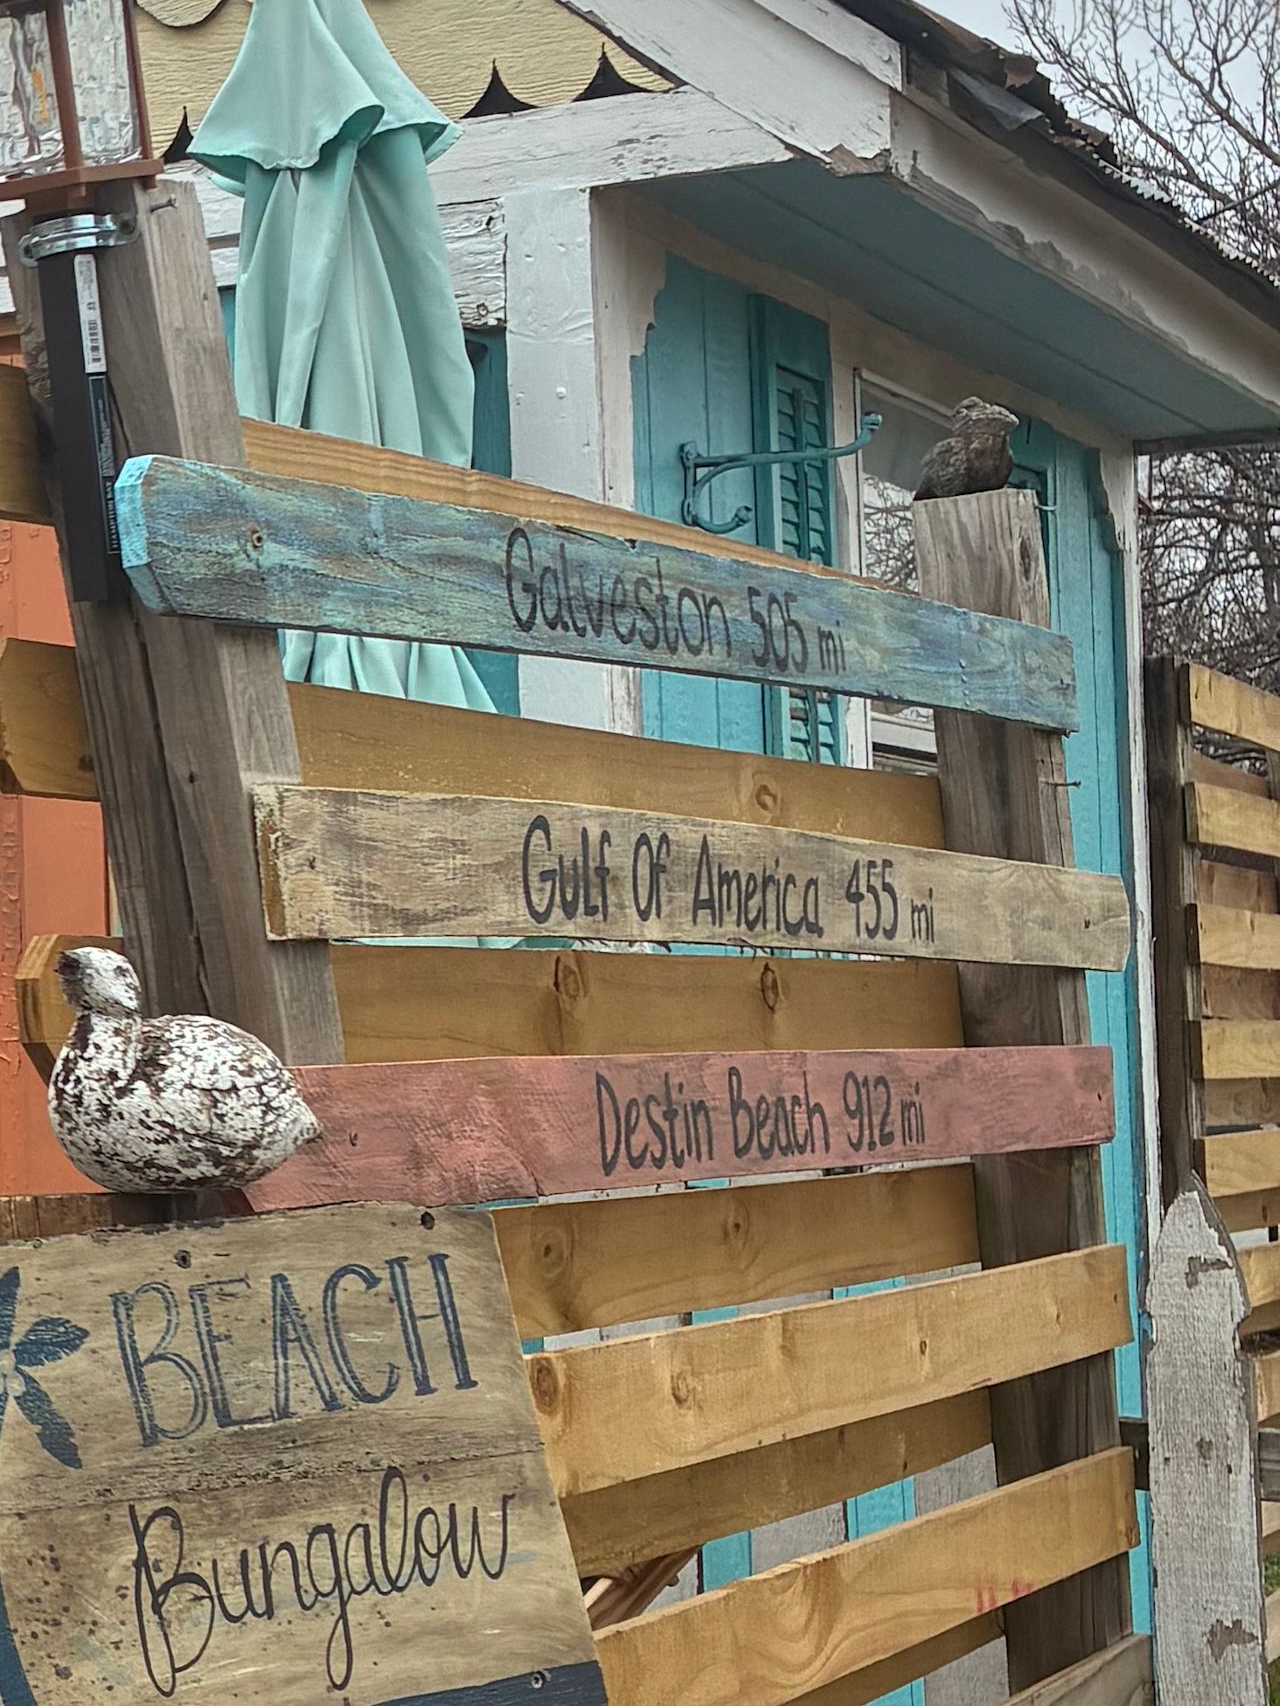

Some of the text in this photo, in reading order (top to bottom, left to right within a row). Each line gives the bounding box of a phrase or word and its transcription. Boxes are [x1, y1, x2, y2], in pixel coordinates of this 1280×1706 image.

[505, 527, 846, 674] Galveston 505 mi
[522, 814, 936, 943] Gulf Of America 455 mi
[595, 1066, 926, 1176] Destin Beach 912 mi
[111, 1253, 478, 1448] BEACH
[128, 1466, 517, 1697] Bungalow
